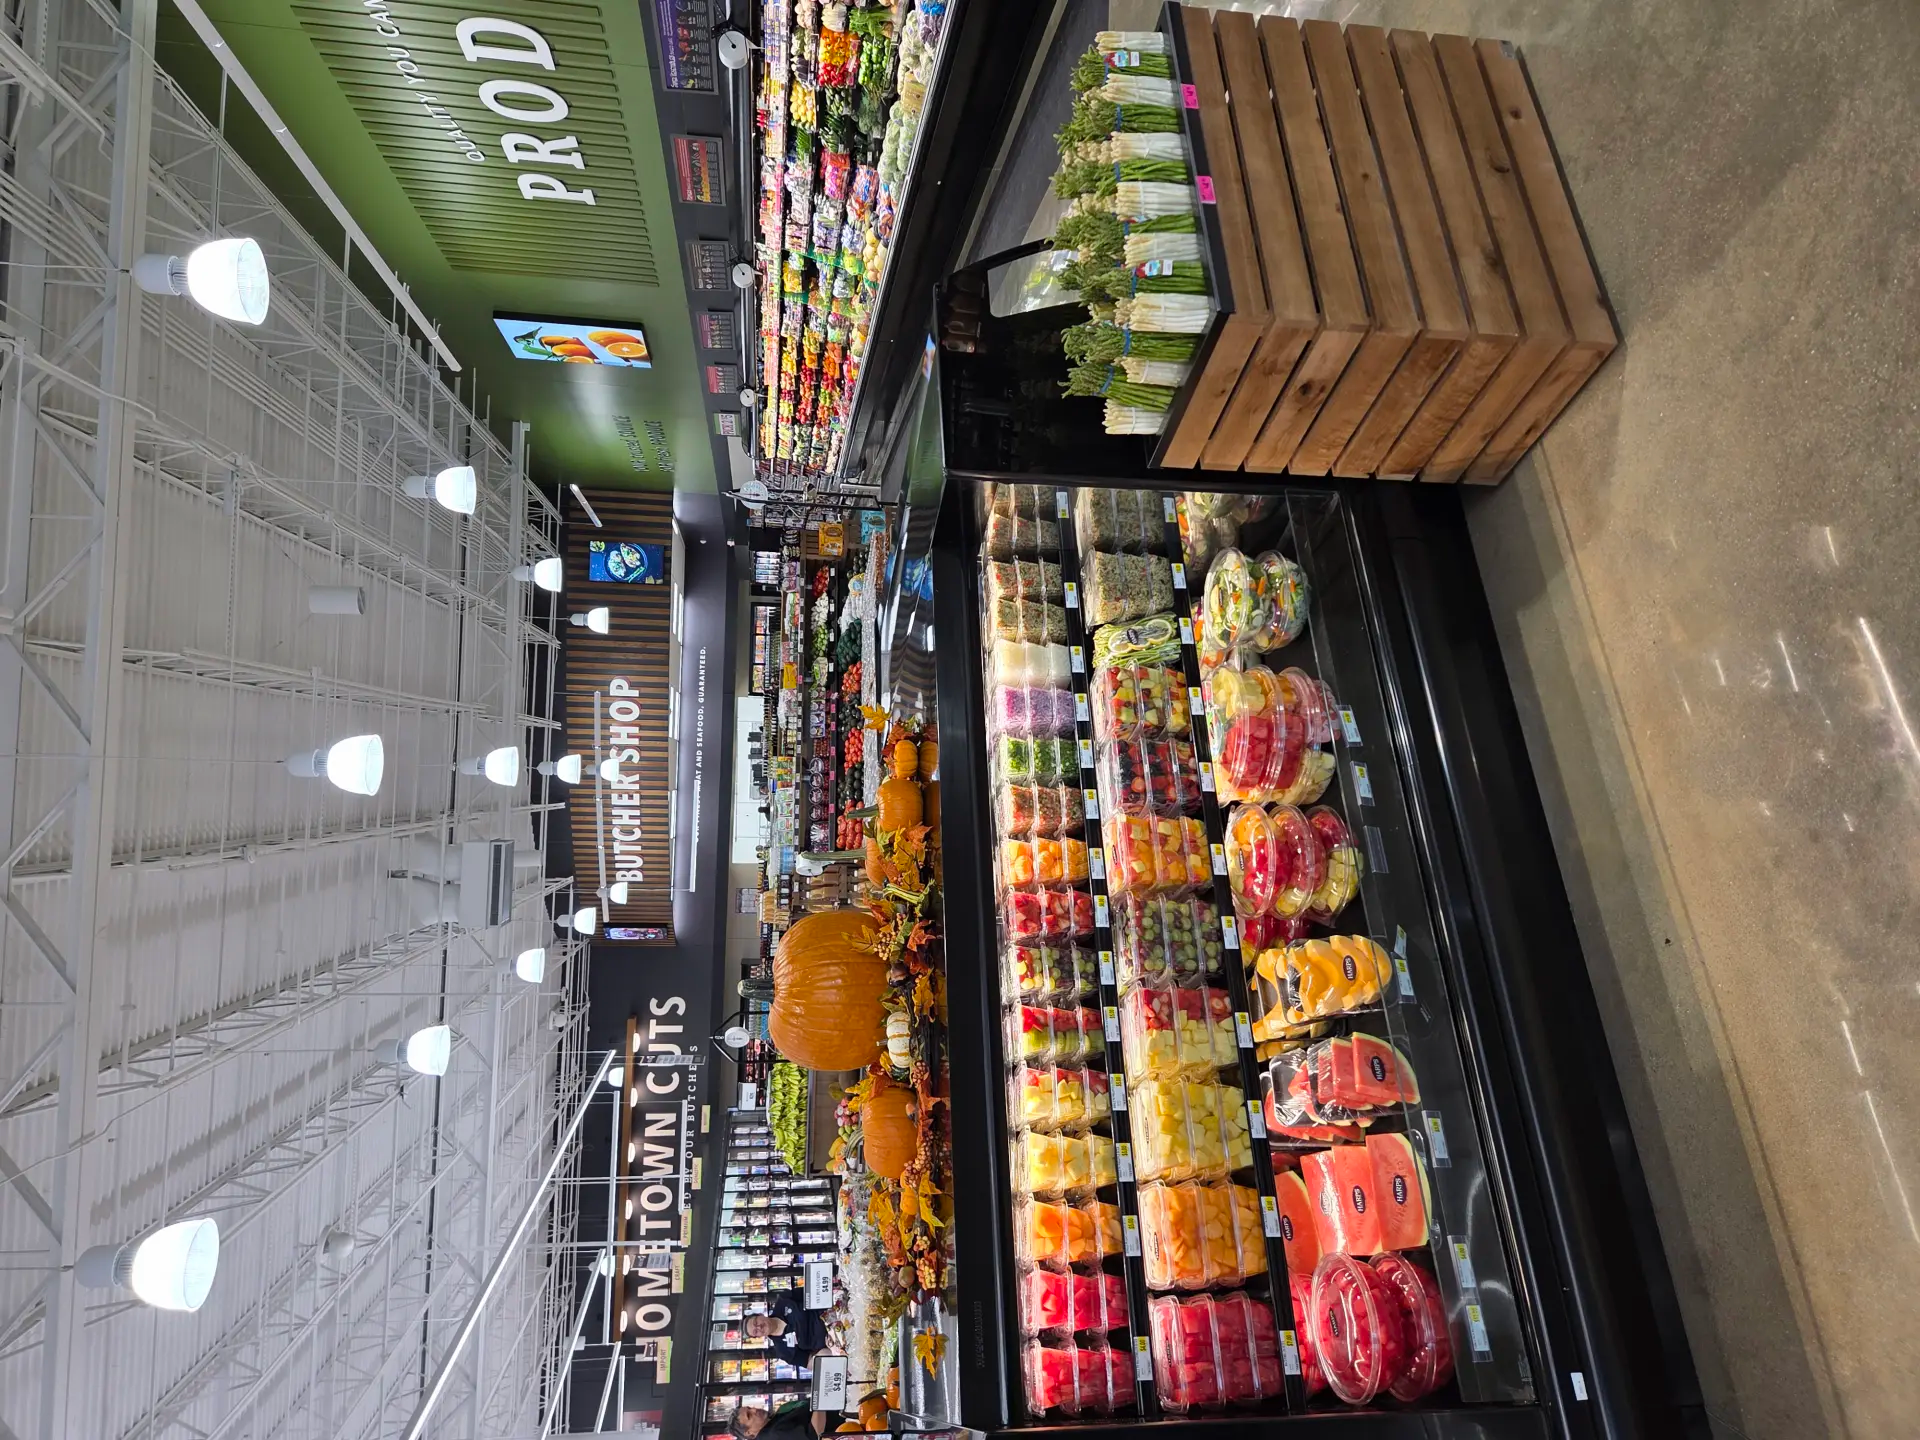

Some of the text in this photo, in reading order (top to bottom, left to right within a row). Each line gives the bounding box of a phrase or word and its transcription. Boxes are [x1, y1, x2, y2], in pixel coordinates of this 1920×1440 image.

[387, 46, 426, 84] YOU
[455, 16, 597, 206] PROD
[416, 92, 486, 162] QUALITY
[644, 420, 667, 446] PRODUCE
[608, 676, 644, 882] BUTCHER SHOP
[1344, 957, 1354, 978] HARPS
[646, 996, 686, 1094] CUTS
[1373, 1058, 1383, 1079] HARPS
[687, 1045, 698, 1122] BUTCHES
[686, 1130, 694, 1158] OUR
[1354, 1188, 1364, 1212] HARPS
[1394, 1178, 1404, 1202] HARPS
[1283, 1217, 1291, 1239] HARPS
[660, 1349, 668, 1371] IMPORT
[833, 1373, 841, 1392] $4.99
